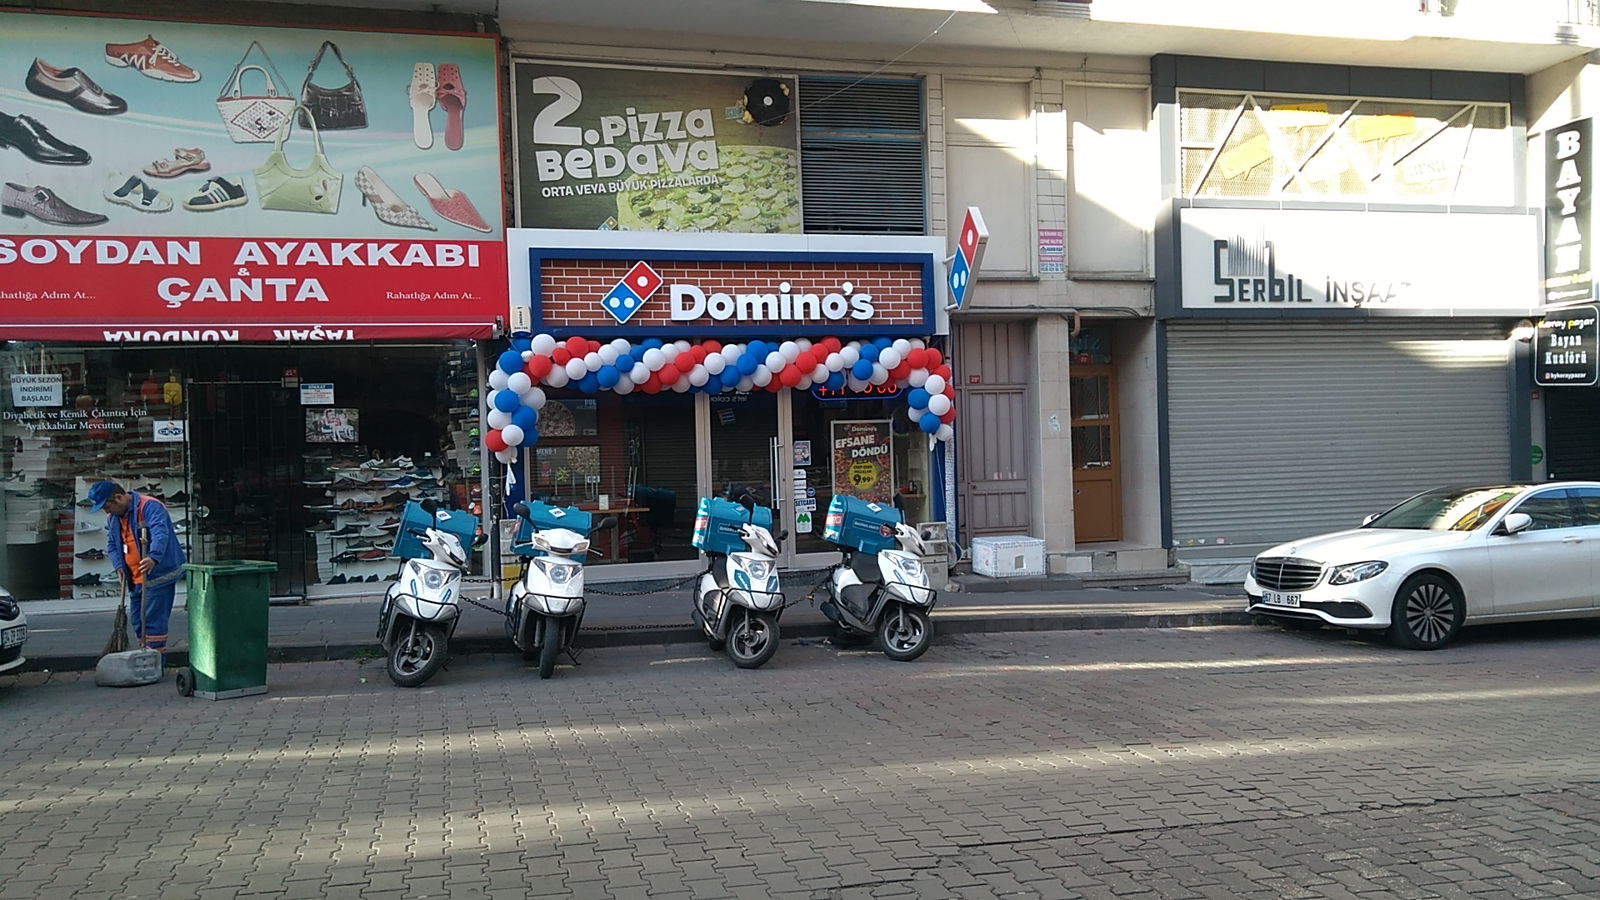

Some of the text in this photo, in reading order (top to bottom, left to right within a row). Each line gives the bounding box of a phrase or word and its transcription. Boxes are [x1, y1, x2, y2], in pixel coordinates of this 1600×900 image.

[542, 174, 719, 198] ORTA VEYA BÜYÜK PİZZALARDA
[1556, 130, 1582, 273] BAYAN
[0, 239, 480, 267] SOYDAN AYAKKABI
[237, 267, 250, 276] &
[41, 290, 71, 300] Adım
[157, 277, 329, 308] ÇANTA
[386, 291, 431, 302] Rahatlığa
[433, 291, 459, 301] Adım
[669, 281, 874, 321] Domino's
[1551, 334, 1582, 349] Bayan
[1545, 351, 1587, 365] Kuaförü
[11, 375, 62, 384] BÜYÜK SEZON
[20, 385, 53, 393] İNDİRİMİ
[21, 395, 52, 403] BAŞLADI
[3, 410, 46, 420] Diyabetik
[60, 410, 88, 419] Kemik
[130, 407, 148, 417] İçin
[25, 421, 126, 431] Ayakkabılar Mevcuttur.
[835, 434, 875, 449] EFSANE
[852, 443, 888, 458] DÖNDÜ
